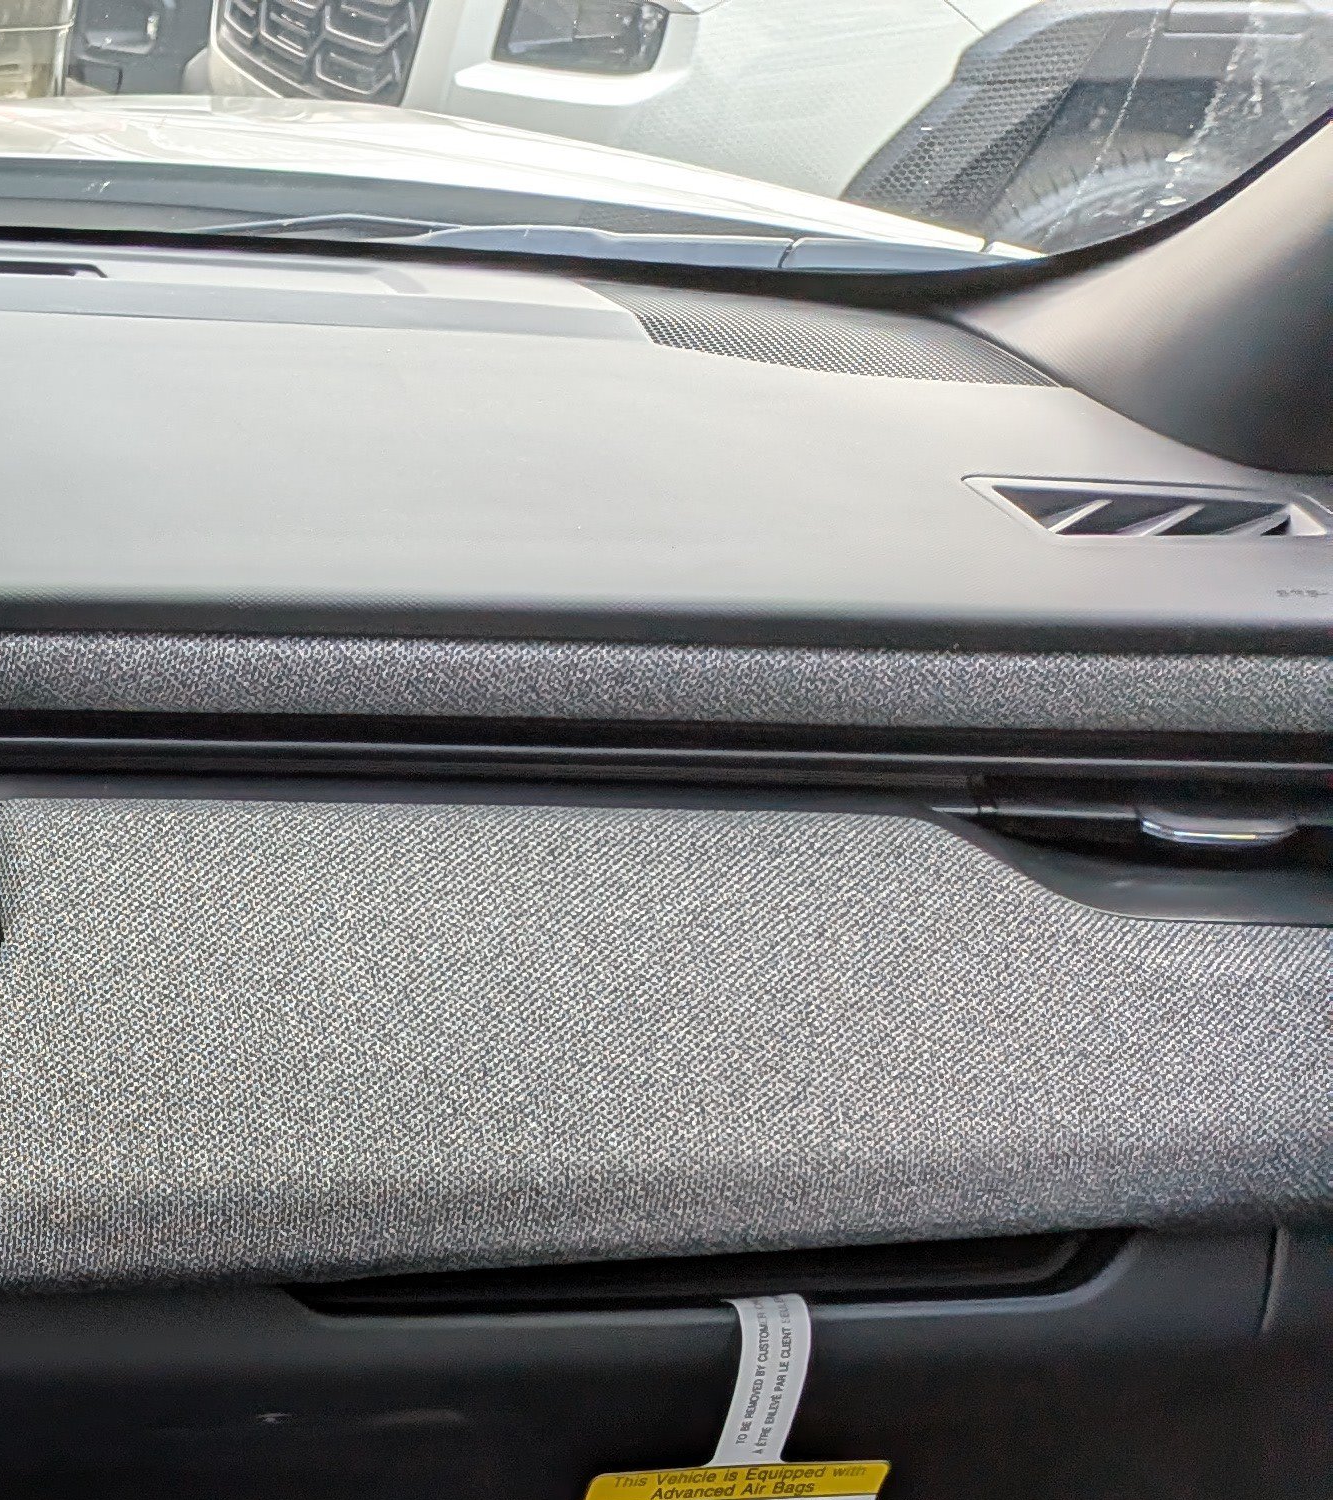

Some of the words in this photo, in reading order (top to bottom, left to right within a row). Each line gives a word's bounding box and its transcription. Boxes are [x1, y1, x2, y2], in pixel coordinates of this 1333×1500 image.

[755, 1365, 767, 1378] BY
[778, 1361, 790, 1373] LE
[774, 1375, 786, 1392] PAR
[740, 1420, 752, 1432] BE
[735, 1433, 748, 1445] TO
[615, 1476, 648, 1488] This
[656, 1471, 716, 1486] Vehicle
[723, 1469, 738, 1481] is
[745, 1466, 826, 1482] Equipped
[651, 1484, 735, 1500] Advanced
[740, 1482, 766, 1495] Air
[771, 1482, 815, 1496] Bags
